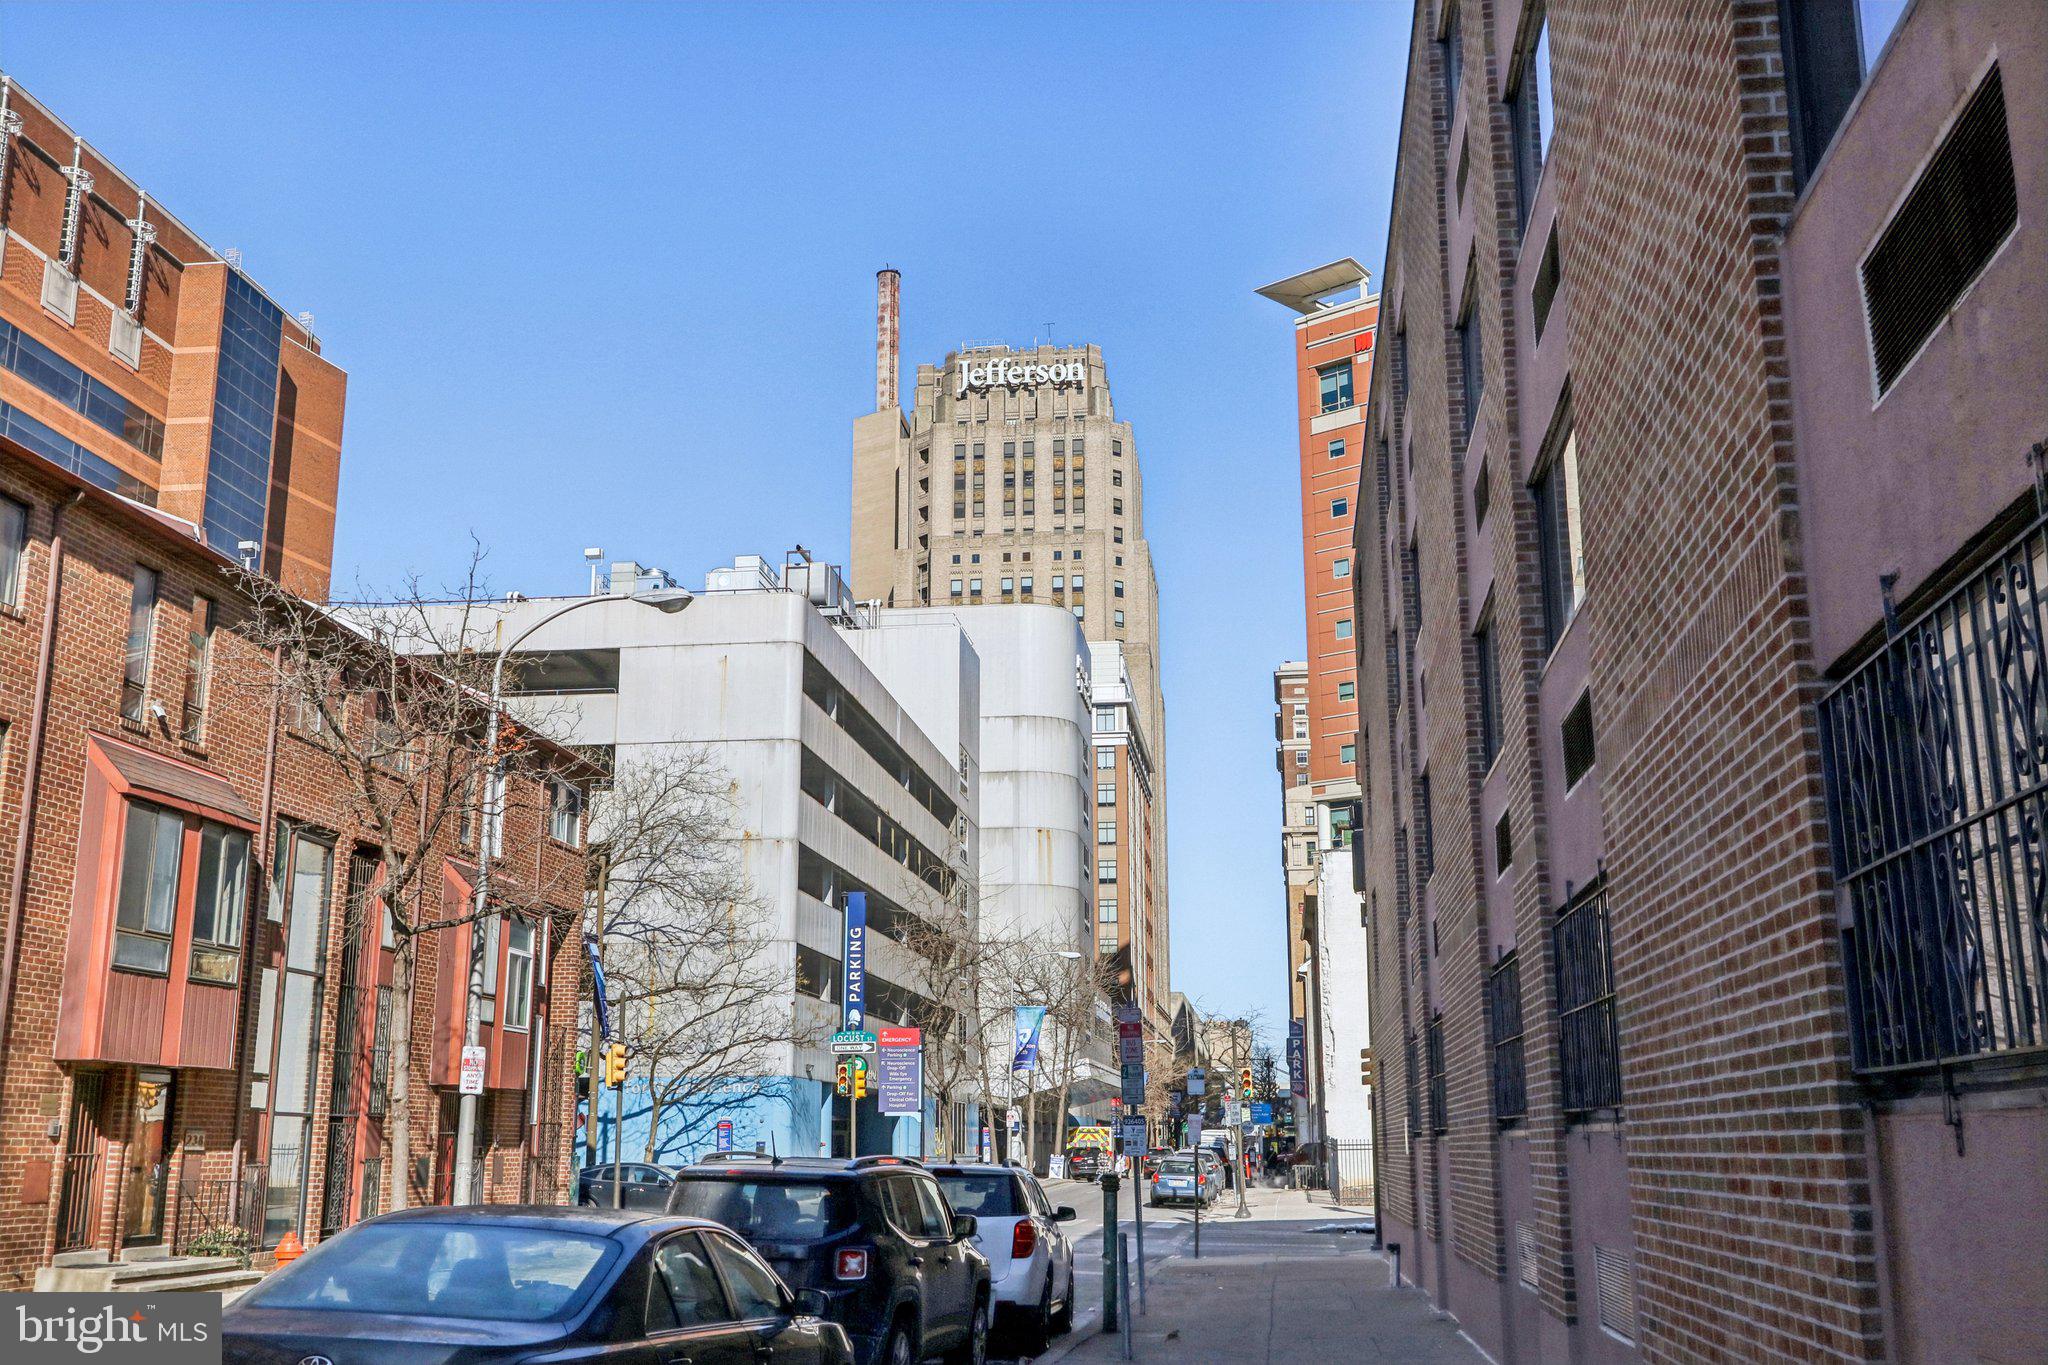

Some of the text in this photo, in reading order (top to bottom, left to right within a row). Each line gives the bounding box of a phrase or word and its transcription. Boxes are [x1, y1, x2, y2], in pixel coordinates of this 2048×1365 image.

[956, 358, 1085, 399] Jefferson
[849, 927, 862, 1002] PARKING
[1293, 1040, 1302, 1078] PARK
